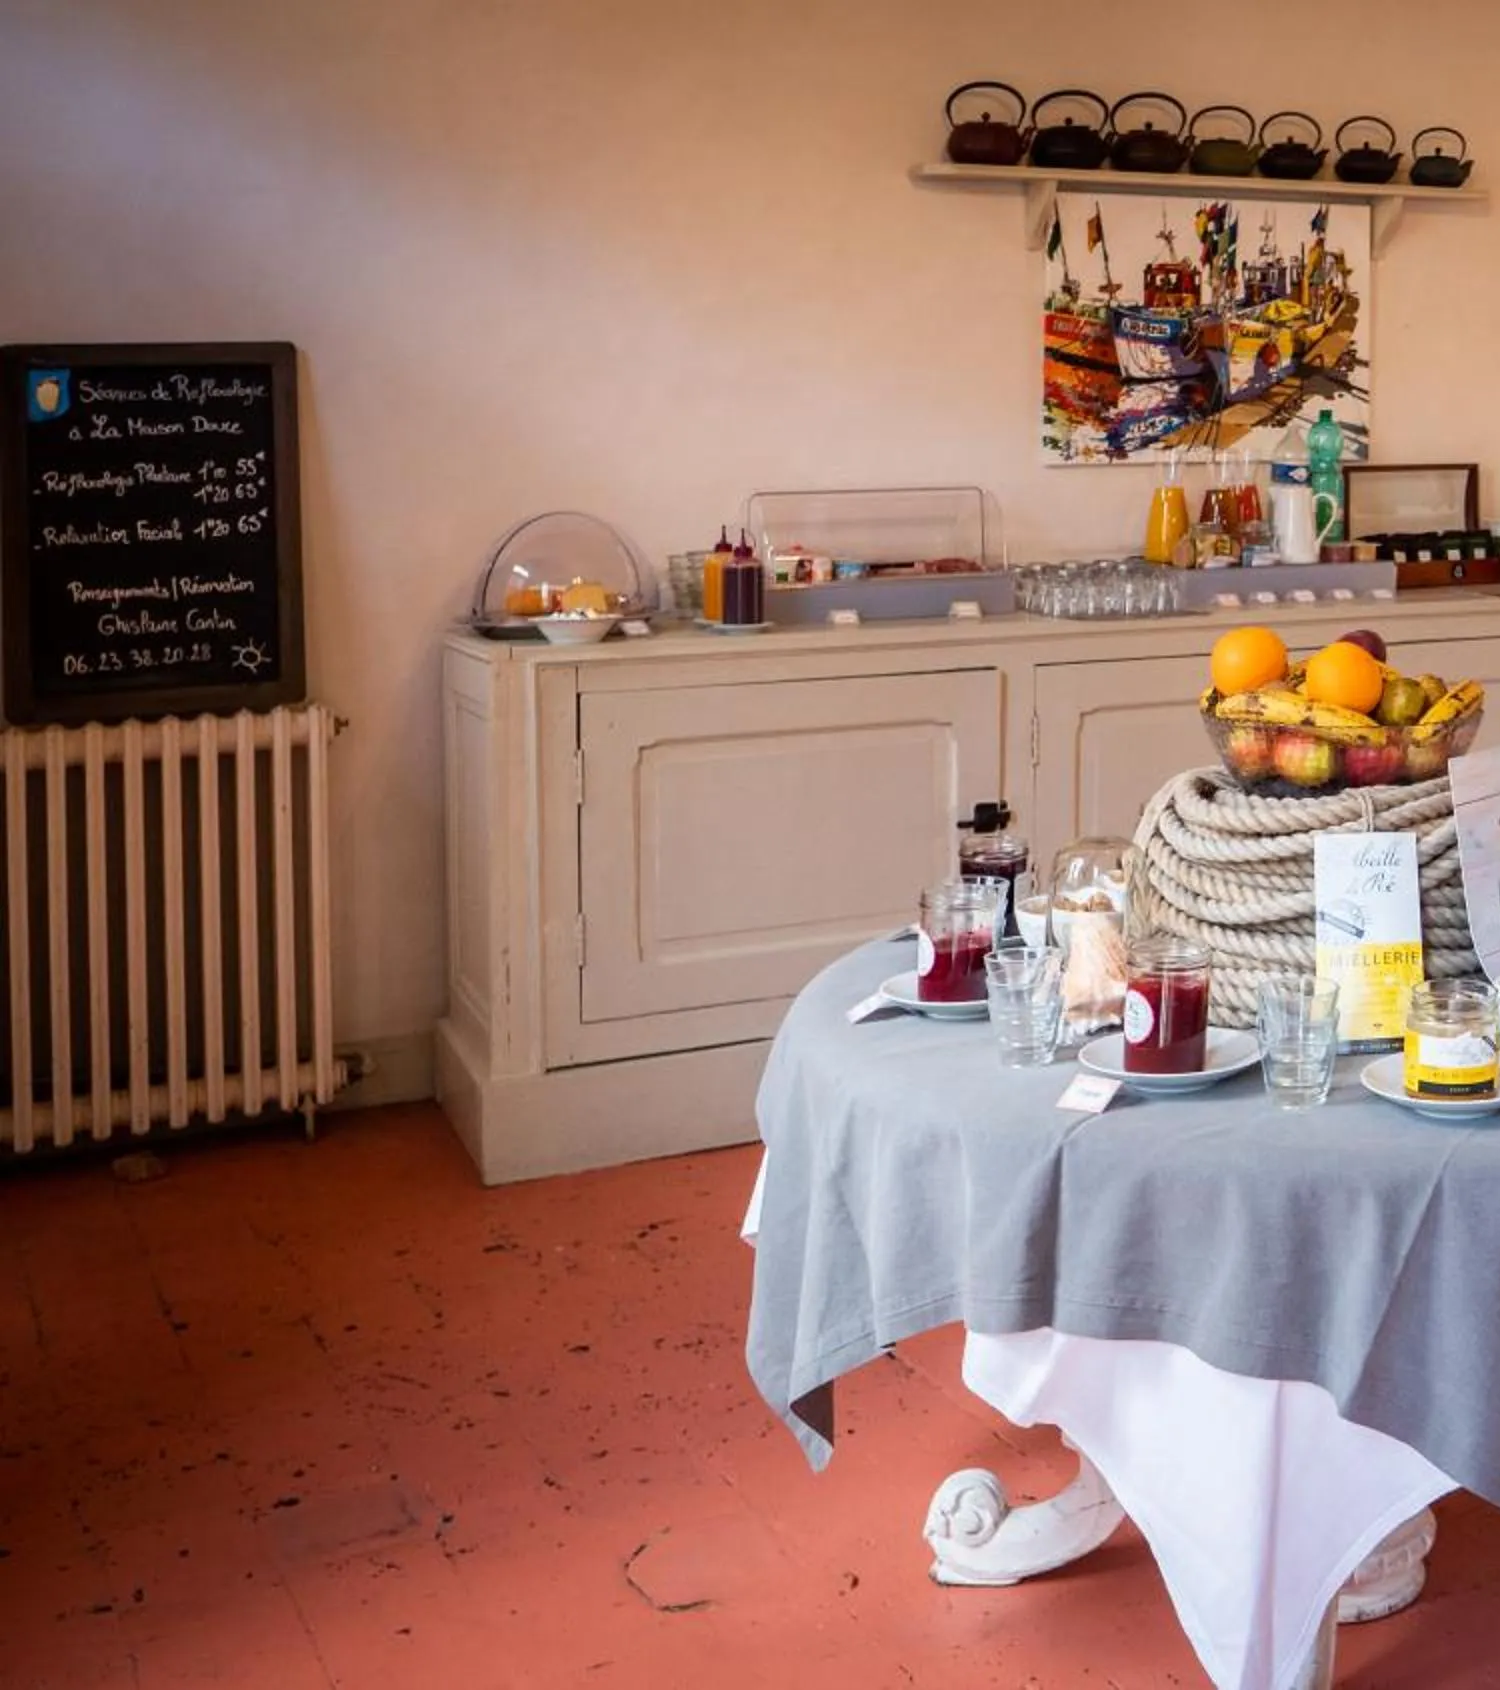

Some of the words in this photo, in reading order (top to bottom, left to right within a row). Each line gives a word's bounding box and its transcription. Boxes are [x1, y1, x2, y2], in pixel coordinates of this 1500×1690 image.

[90, 414, 123, 439] La
[127, 417, 185, 437] Maison
[191, 415, 245, 435] Douce
[1329, 950, 1421, 970] MIELLERIE
